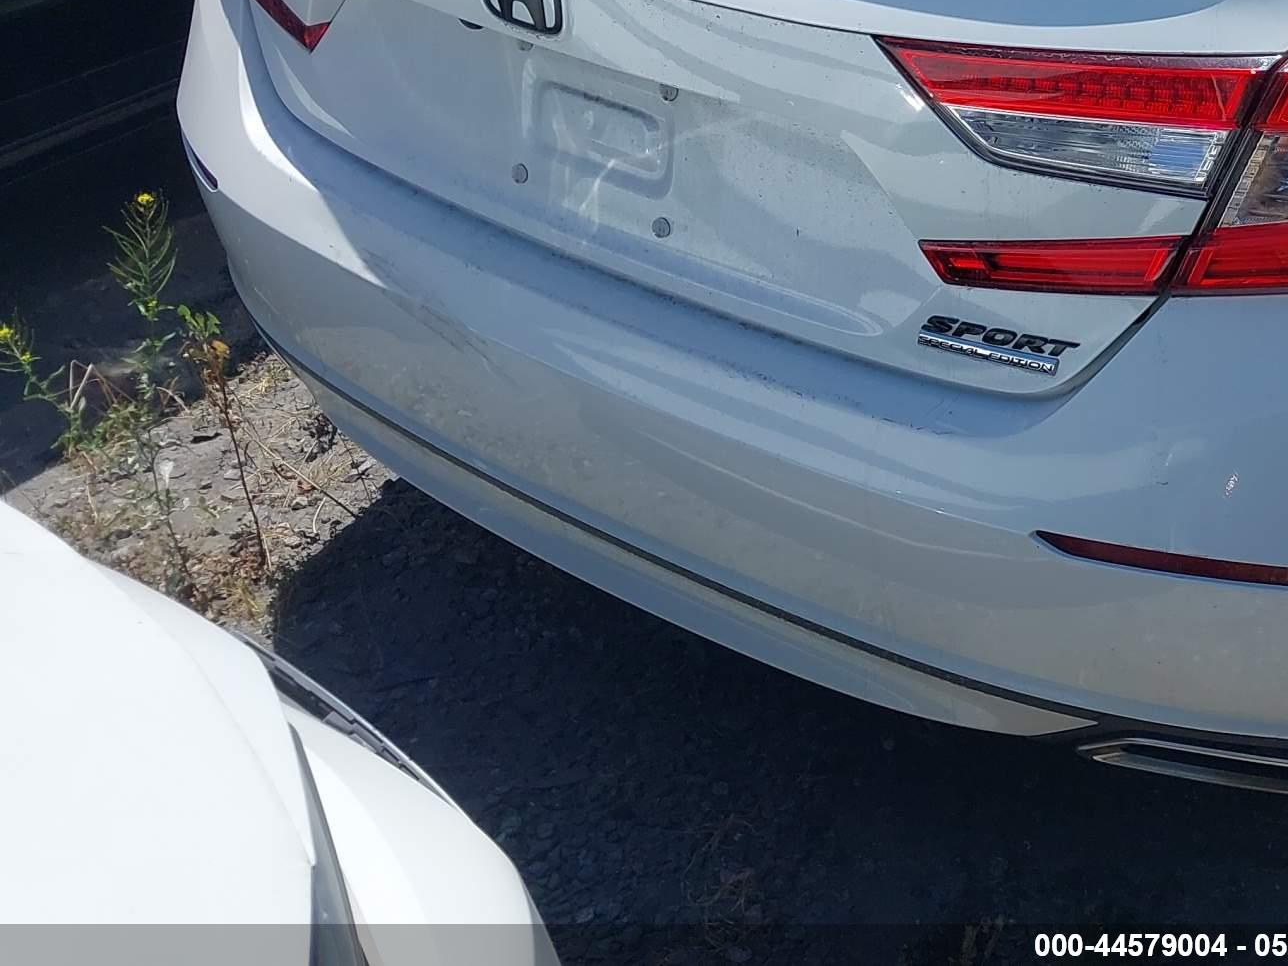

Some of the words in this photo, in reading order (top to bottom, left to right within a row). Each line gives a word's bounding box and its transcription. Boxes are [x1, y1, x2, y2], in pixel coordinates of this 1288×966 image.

[917, 335, 983, 358] SPECIAL
[988, 352, 1056, 374] EDITION
[921, 315, 1081, 357] SPORT
